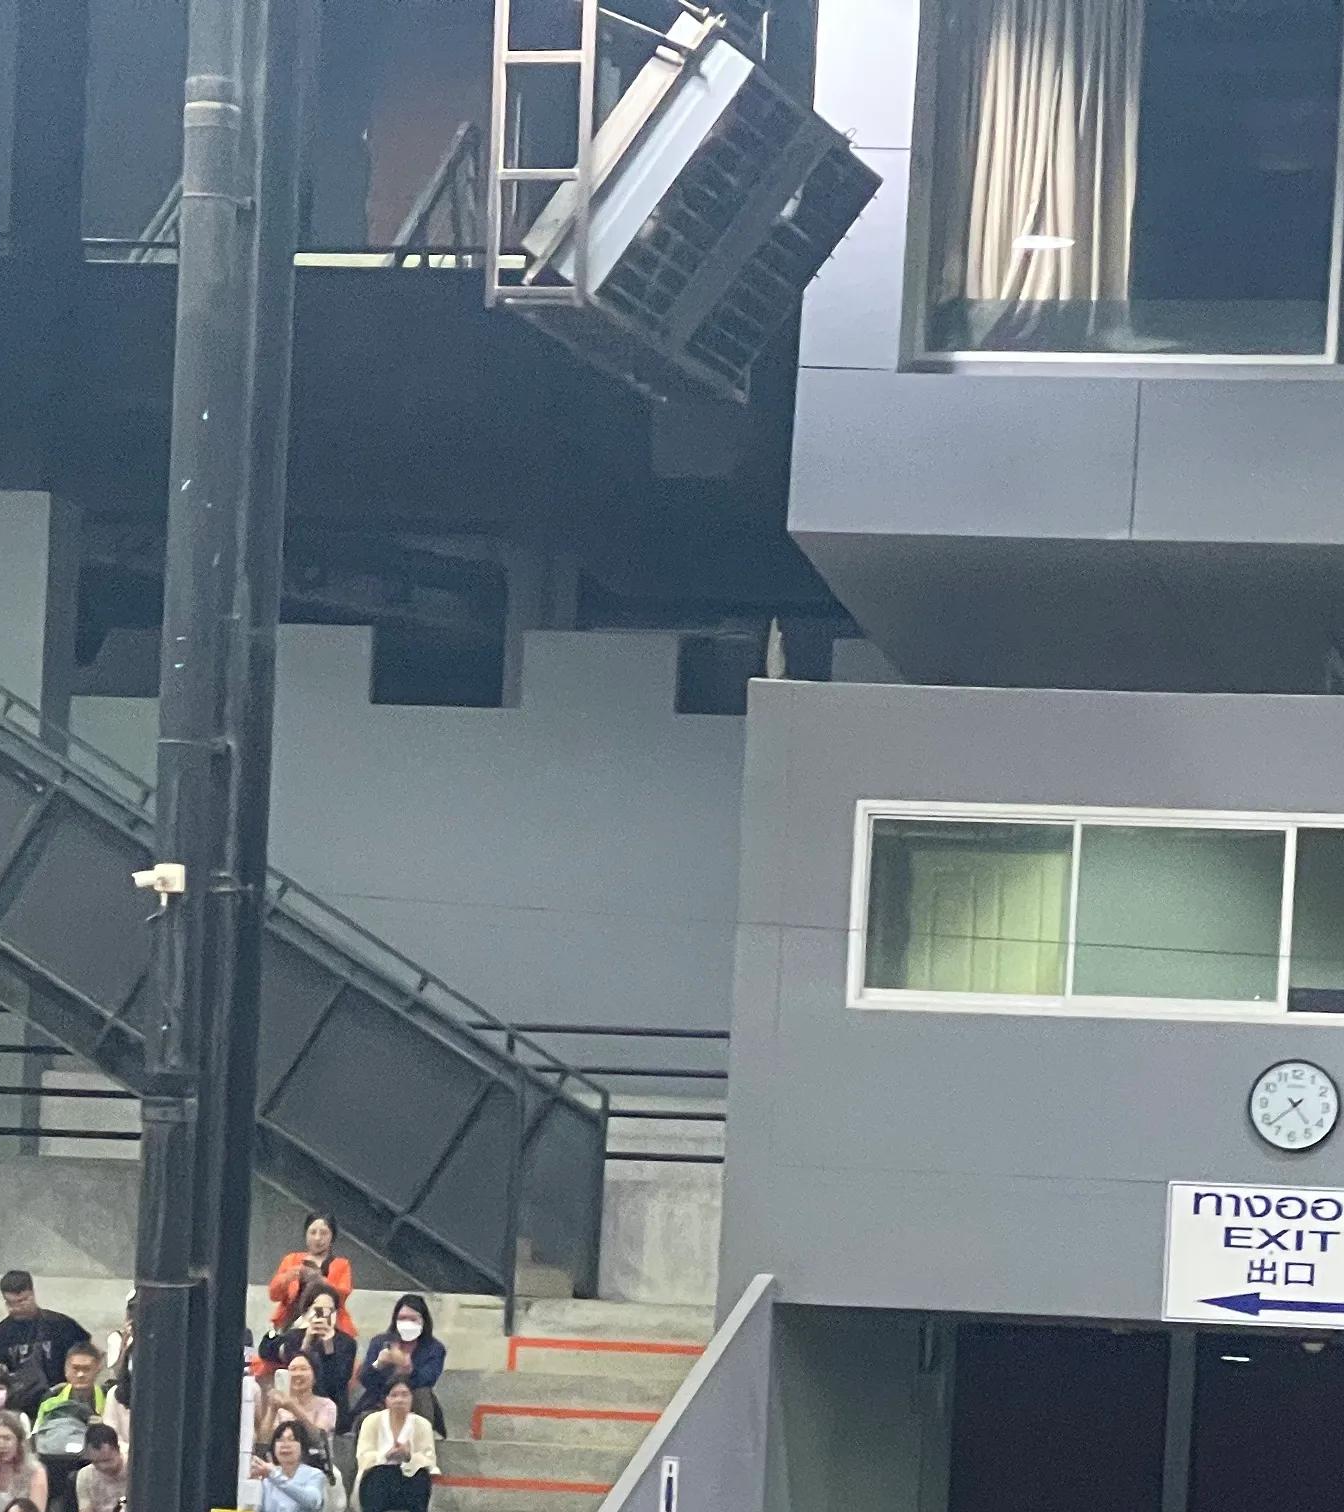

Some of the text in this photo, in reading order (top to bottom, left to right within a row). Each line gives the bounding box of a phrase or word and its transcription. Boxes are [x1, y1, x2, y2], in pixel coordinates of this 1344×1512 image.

[1319, 1086, 1329, 1098] 2
[1287, 1130, 1297, 1142] 6
[1223, 1227, 1341, 1252] EXIT
[1247, 1258, 1315, 1287] 出口
